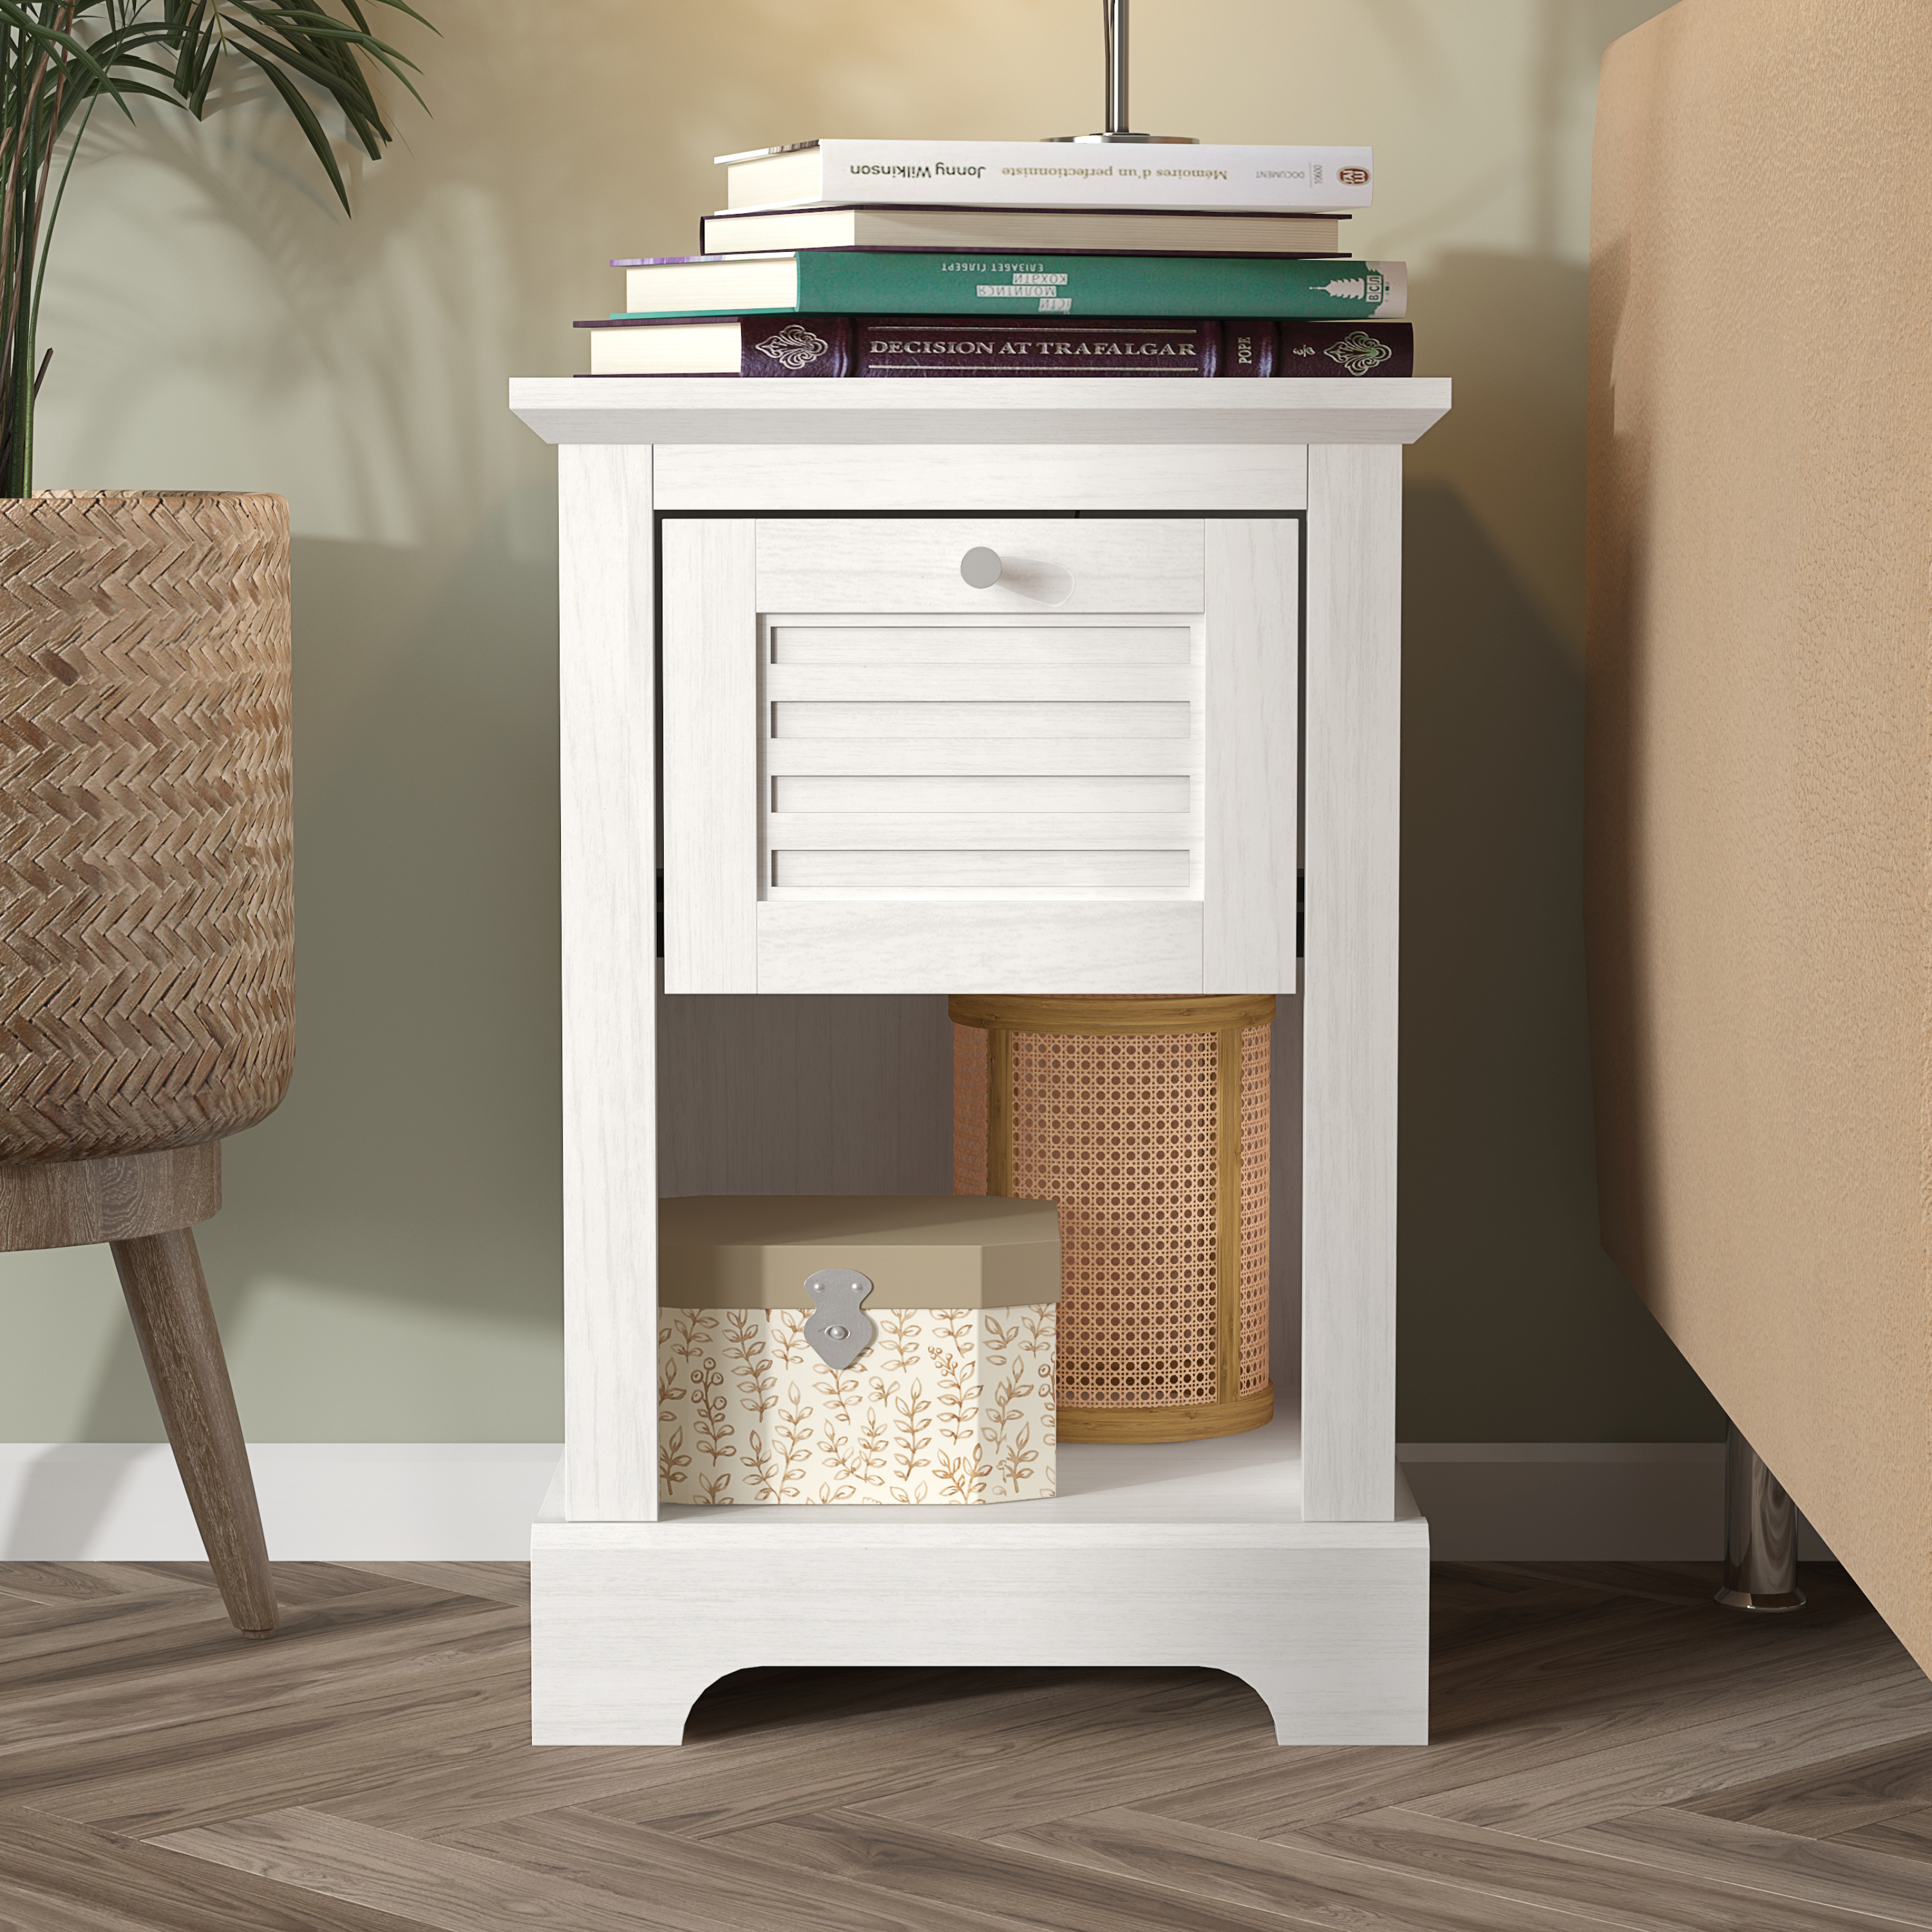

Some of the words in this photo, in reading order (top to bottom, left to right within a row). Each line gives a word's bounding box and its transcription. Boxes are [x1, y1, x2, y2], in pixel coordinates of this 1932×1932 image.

[850, 165, 931, 178] Wilkinson
[936, 162, 986, 178] Jonny
[1001, 166, 1113, 179] perfectionniste
[1119, 168, 1151, 180] d'un
[1157, 168, 1227, 180] Mémoires
[1256, 171, 1305, 179] DOCUMENT
[990, 263, 1043, 272] ЕЛІЗАБЕТ
[869, 340, 995, 355] DECISION
[998, 341, 1032, 355] AT
[1036, 342, 1197, 356] TRAFALGAR
[1238, 337, 1252, 365] POPE
